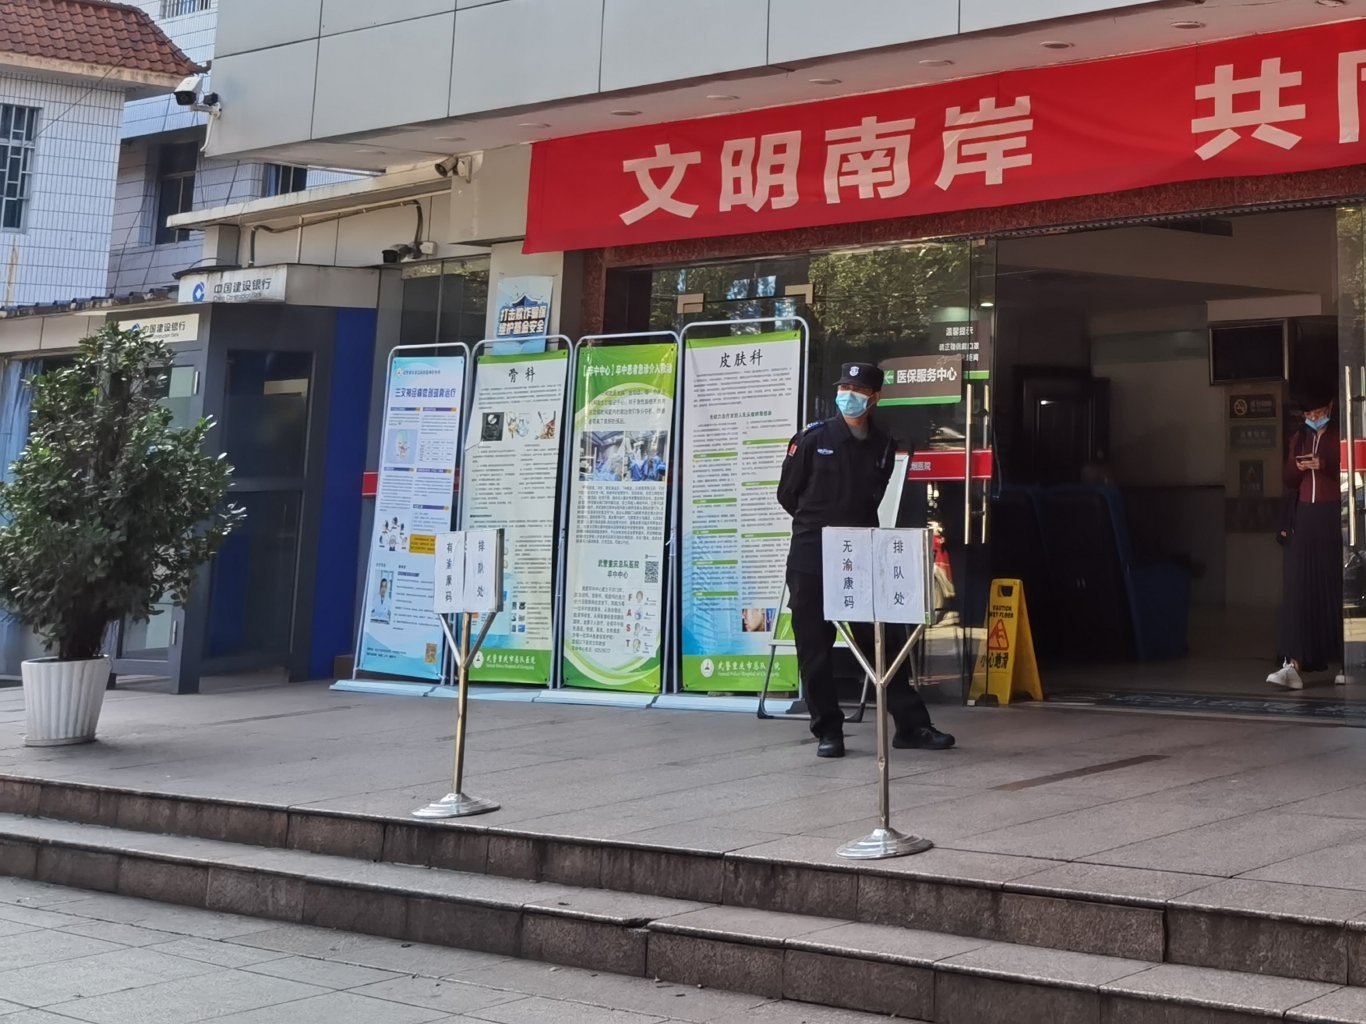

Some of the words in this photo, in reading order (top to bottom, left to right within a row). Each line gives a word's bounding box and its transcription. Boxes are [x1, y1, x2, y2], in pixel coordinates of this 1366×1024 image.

[618, 94, 1035, 226] 文明南岸
[213, 278, 272, 294] 中国建设银行
[720, 349, 763, 368] 皮肤科
[896, 367, 958, 384] 医保服务中心
[842, 540, 855, 609] 无渝康码
[893, 540, 905, 606] 排队处
[718, 660, 781, 672] 武警重庆市总队院
